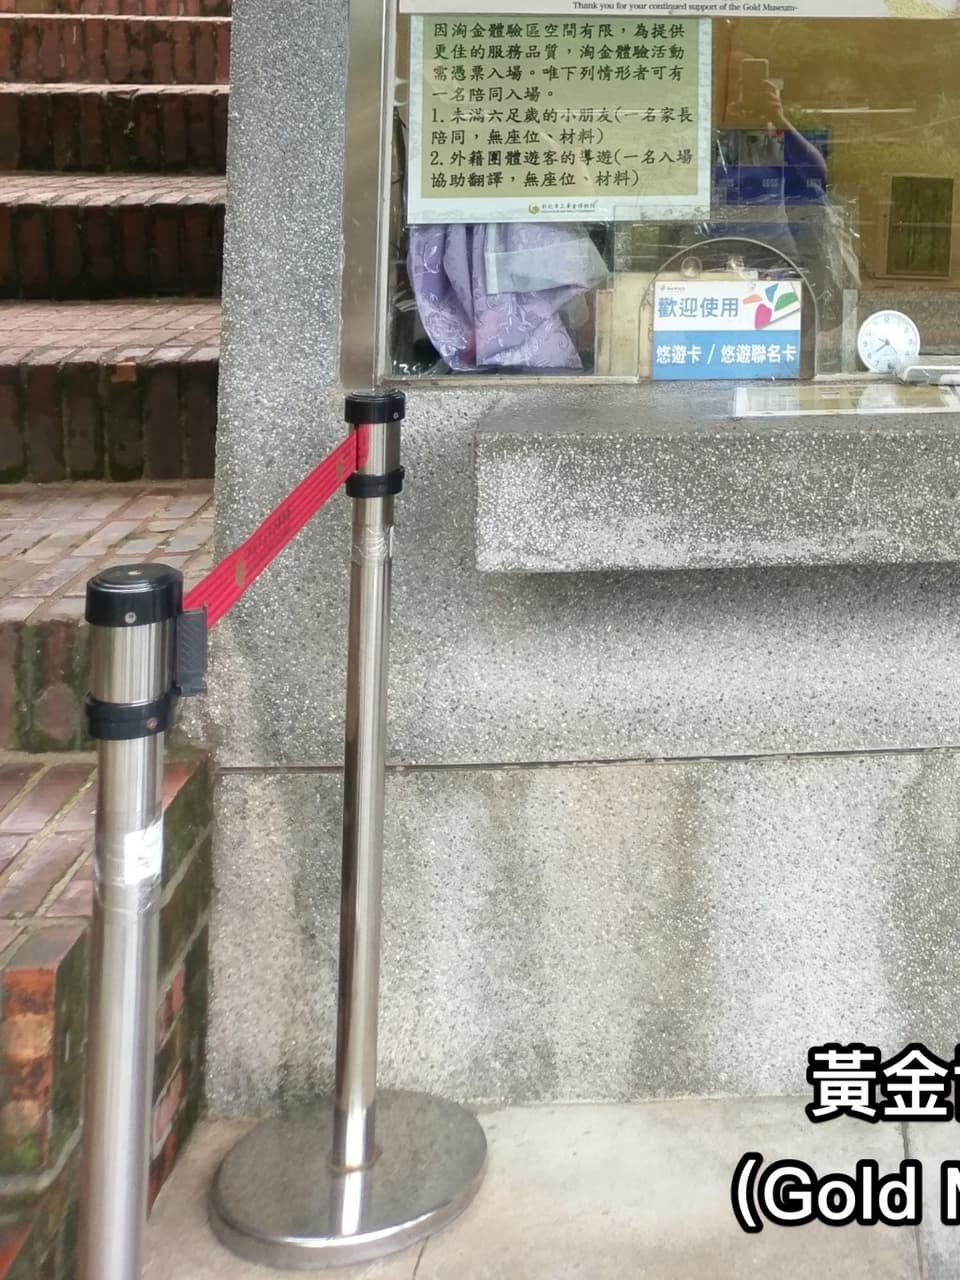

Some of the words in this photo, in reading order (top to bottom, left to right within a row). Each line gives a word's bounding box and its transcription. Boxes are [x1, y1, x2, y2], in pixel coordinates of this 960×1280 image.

[572, 1, 598, 10] Thank
[599, 3, 614, 12] you
[616, 2, 627, 10] for
[629, 3, 647, 12] your
[648, 2, 687, 11] continued
[688, 3, 717, 13] support
[719, 2, 728, 11] of
[728, 2, 741, 11] the
[742, 3, 760, 12] Gold
[433, 22, 686, 40] 因淘金體驗區空間有限，為提供
[433, 43, 685, 61] 更佳的服務品質，淘金體驗活動
[431, 86, 554, 103] 一名陪同入場。
[657, 296, 739, 318] 歡迎使用
[655, 344, 702, 365] 悠遊卡
[720, 344, 797, 365] 悠遊聯名卡
